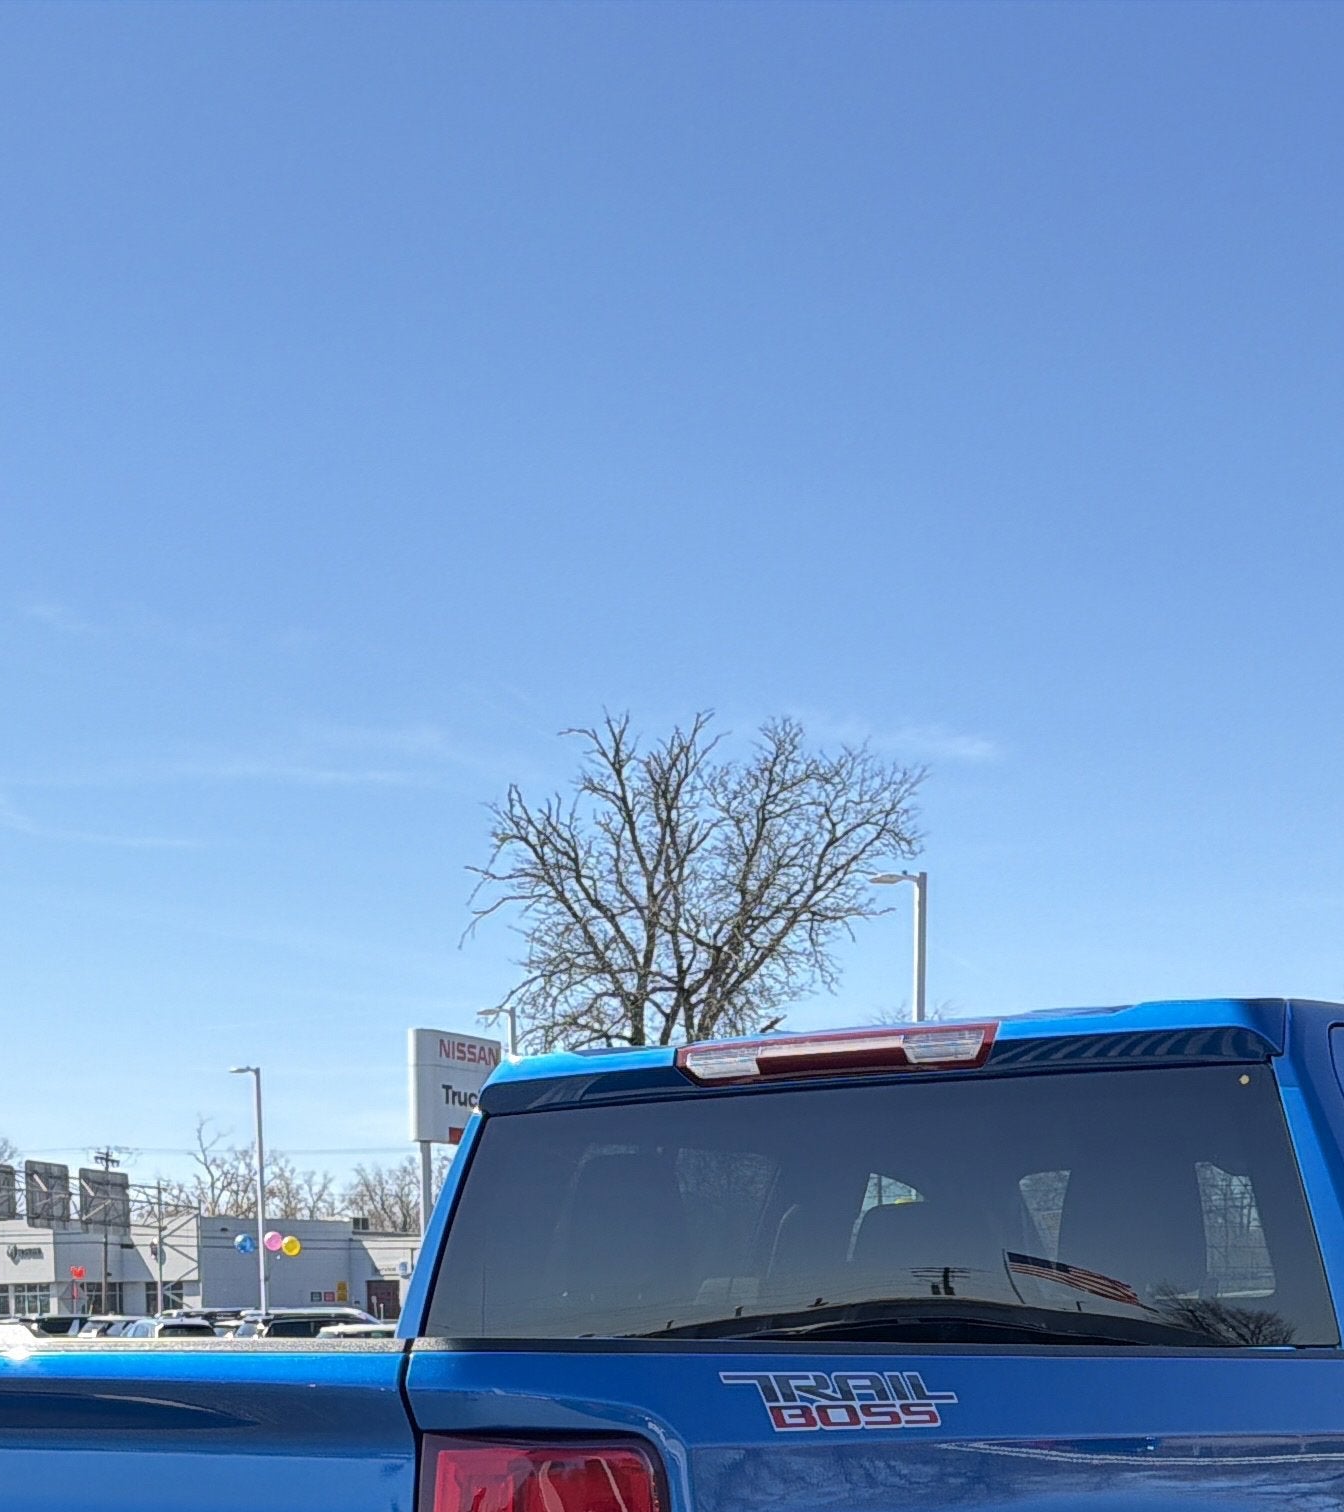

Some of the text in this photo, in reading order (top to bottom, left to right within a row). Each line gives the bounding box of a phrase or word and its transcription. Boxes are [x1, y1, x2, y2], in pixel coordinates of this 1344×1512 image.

[439, 1039, 498, 1067] NISSAN
[441, 1084, 480, 1108] Truc
[719, 1372, 958, 1403] TRAIL
[768, 1402, 941, 1432] BOSS
